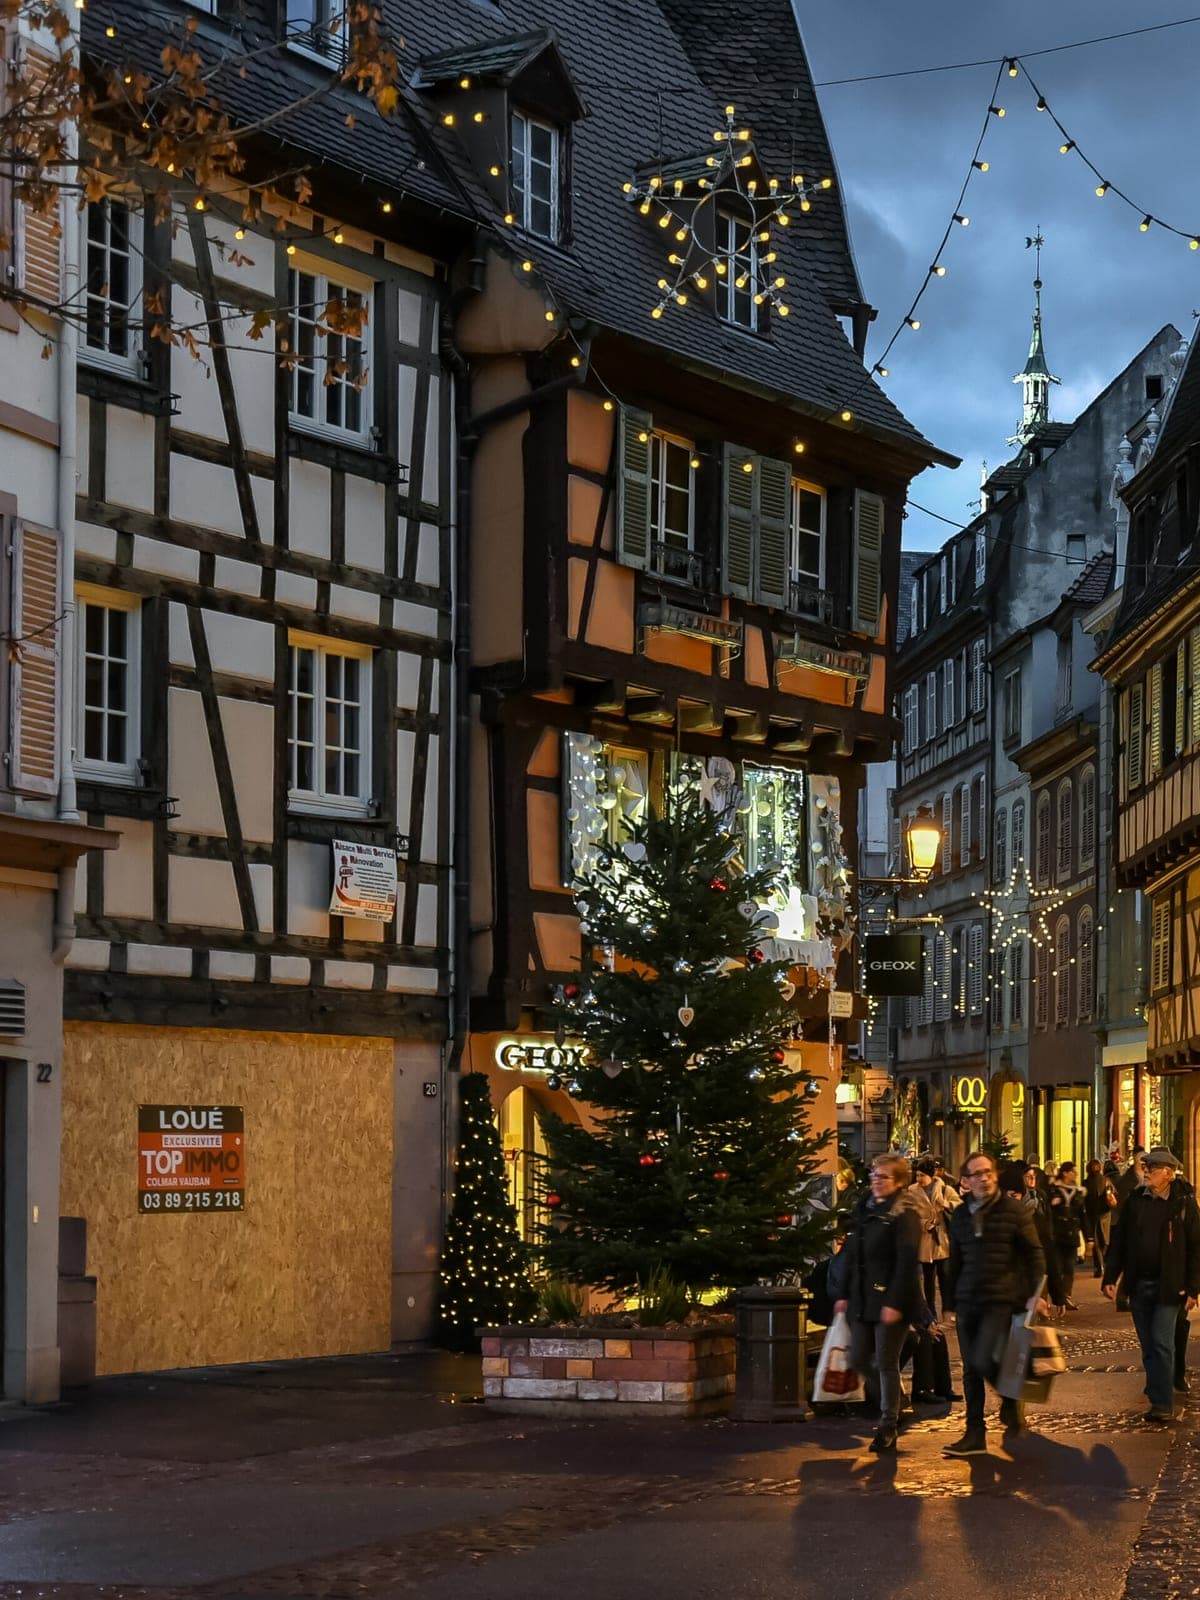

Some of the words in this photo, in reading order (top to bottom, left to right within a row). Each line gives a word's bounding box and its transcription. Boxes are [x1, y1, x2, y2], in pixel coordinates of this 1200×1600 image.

[335, 842, 355, 852] Alsace
[356, 845, 373, 855] Multi
[870, 961, 916, 970] GEOX
[37, 1063, 52, 1083] 22
[425, 1084, 437, 1095] 20
[159, 1107, 224, 1129] LOUÉ
[146, 1178, 178, 1188] COLMAR
[180, 1177, 210, 1187] VAUBAN
[143, 1194, 160, 1209] 03
[165, 1193, 181, 1208] 89
[185, 1192, 210, 1208] 215
[215, 1191, 241, 1207] 218
